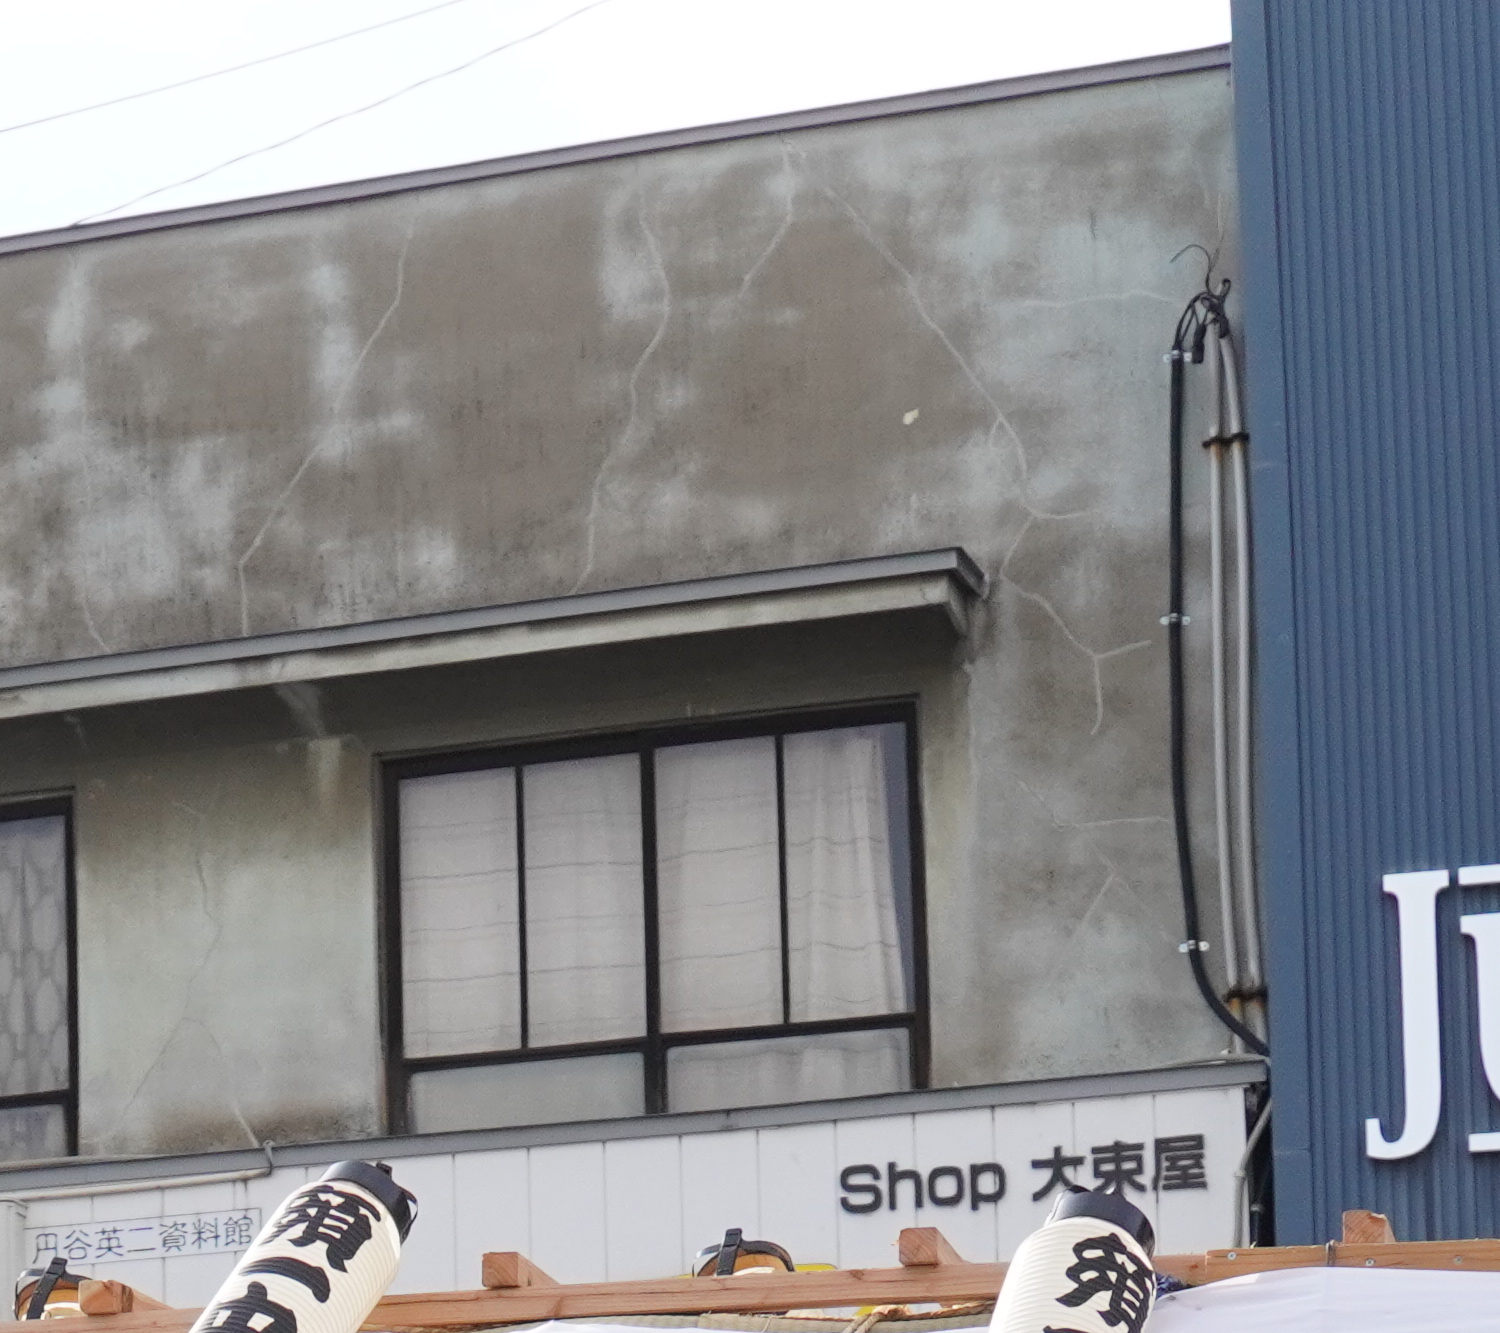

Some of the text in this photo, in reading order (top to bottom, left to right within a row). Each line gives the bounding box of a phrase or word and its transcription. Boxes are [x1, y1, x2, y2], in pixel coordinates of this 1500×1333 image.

[839, 1160, 1007, 1213] Shop
[33, 1216, 255, 1264] 円谷英二資料館
